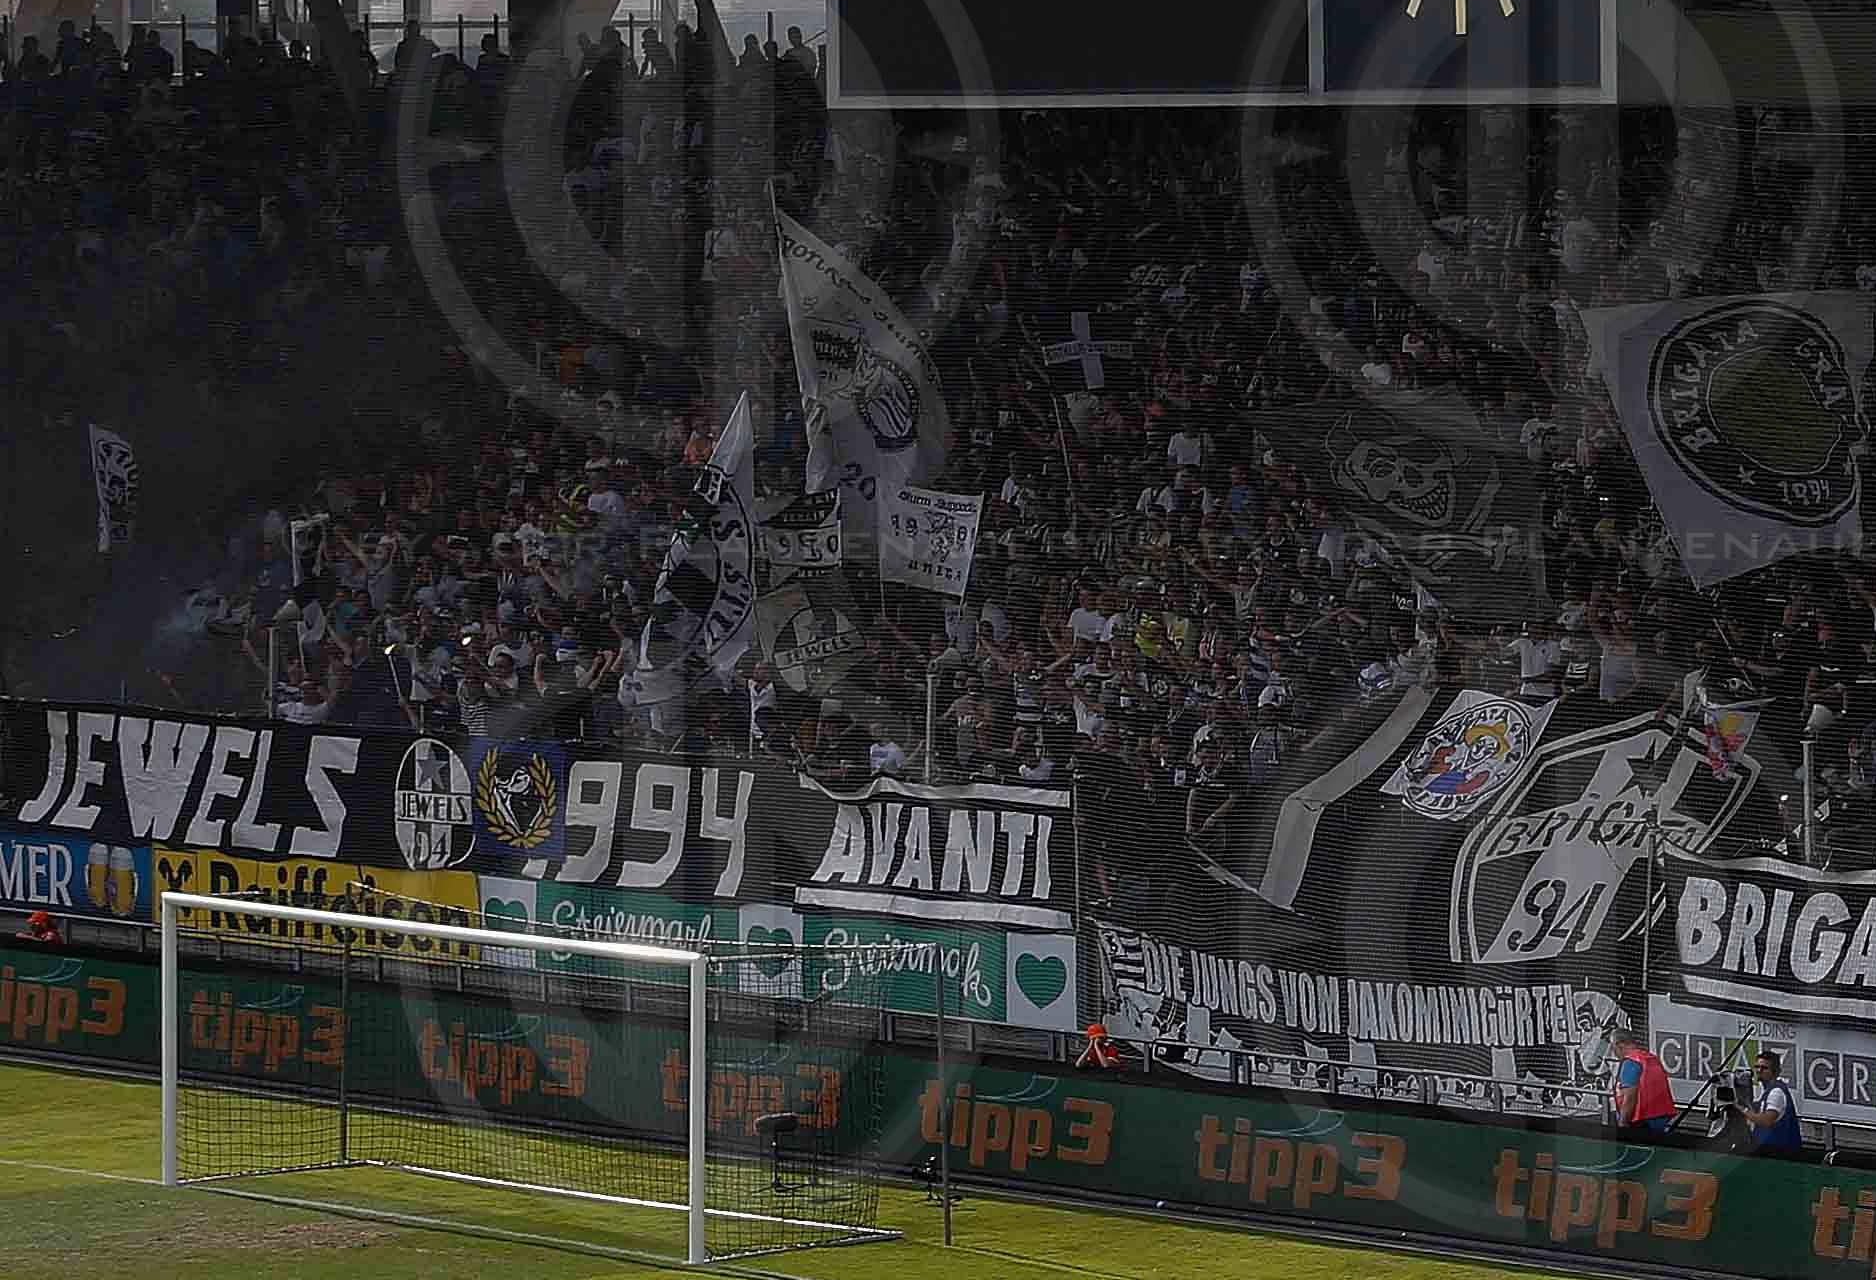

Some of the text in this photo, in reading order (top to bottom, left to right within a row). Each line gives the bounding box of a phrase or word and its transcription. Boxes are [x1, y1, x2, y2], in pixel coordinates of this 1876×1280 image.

[17, 710, 363, 858] JEWELS
[400, 793, 470, 821] JEWELS
[521, 760, 755, 897] 994
[810, 802, 1054, 900] AVANTI
[1506, 879, 1606, 953] 94
[189, 989, 350, 1073] tipp3
[1141, 935, 1584, 1048] DIE JUNGS VOM JAKOMINIGÜRTEL
[419, 1017, 592, 1105] tipp3
[918, 1078, 1116, 1170] tipp3
[1195, 1114, 1407, 1209] tipp3
[1492, 1147, 1723, 1249] tipp3
